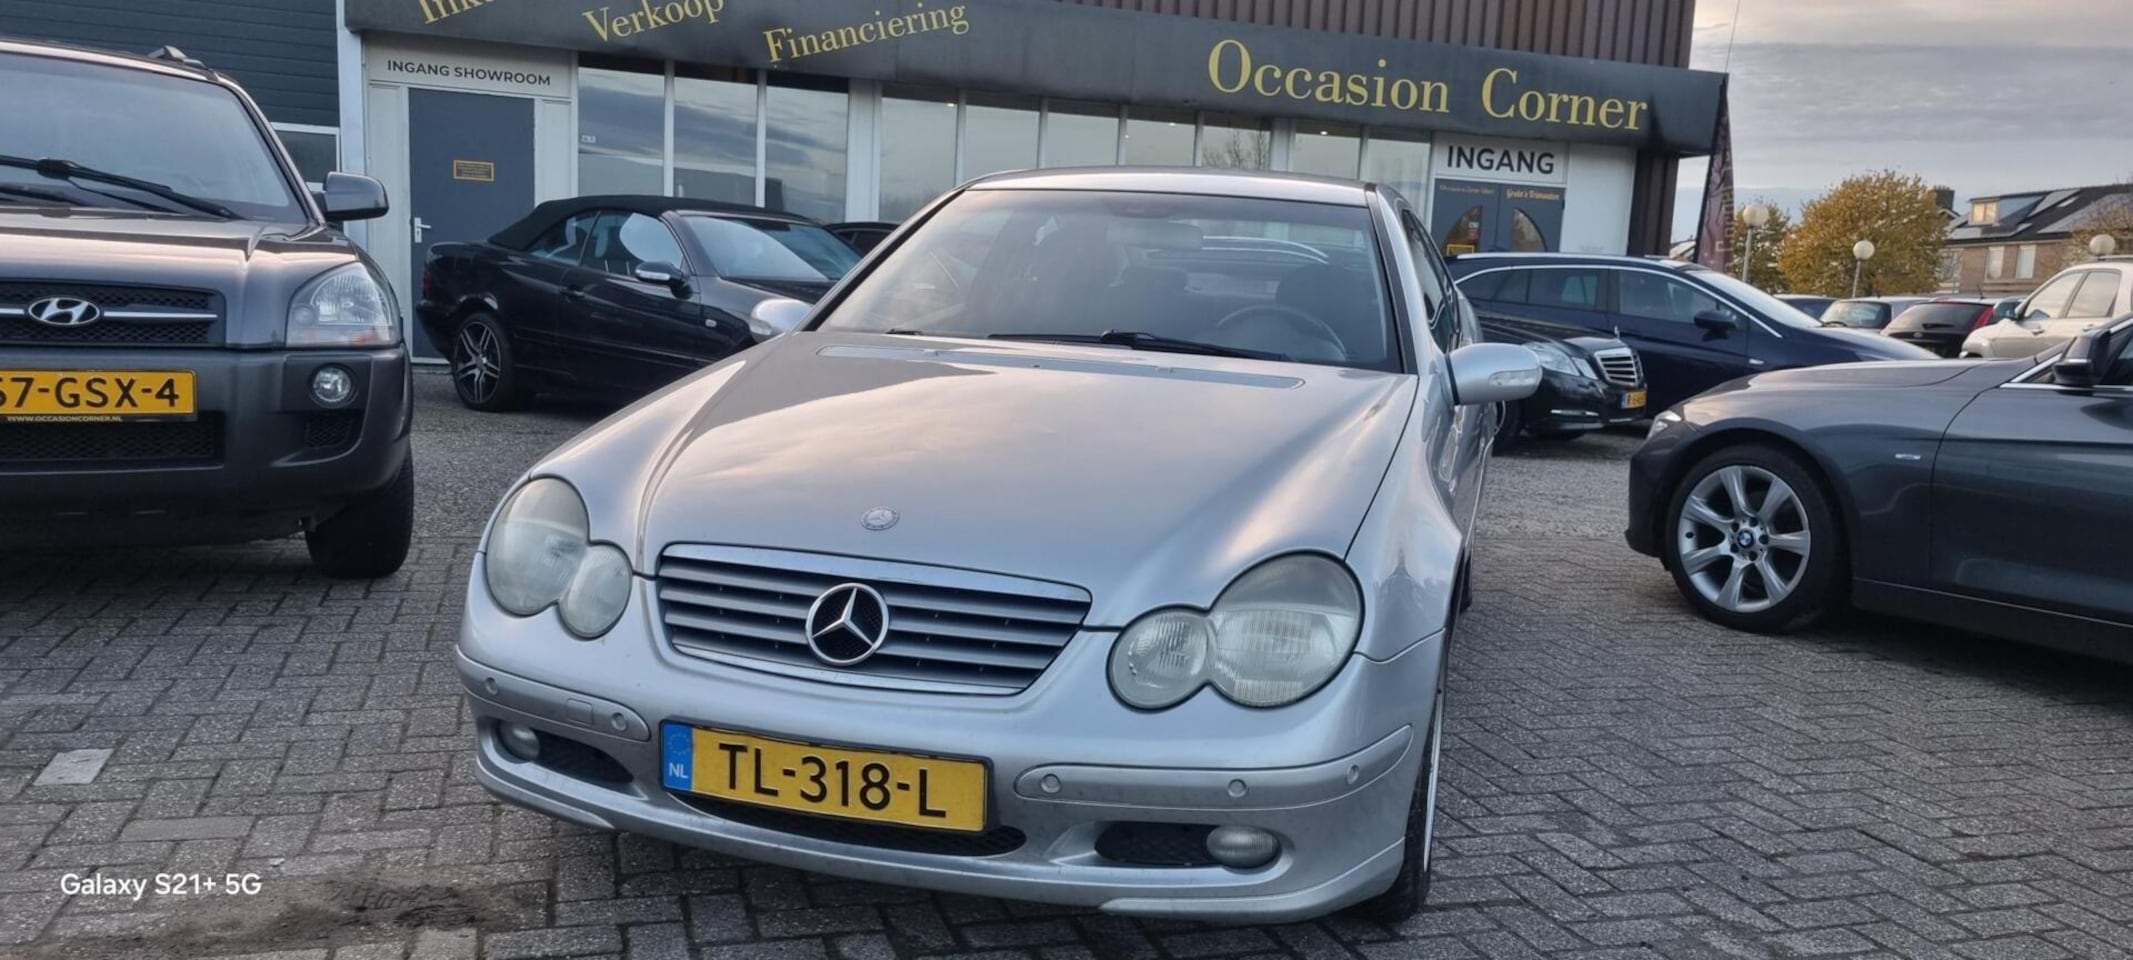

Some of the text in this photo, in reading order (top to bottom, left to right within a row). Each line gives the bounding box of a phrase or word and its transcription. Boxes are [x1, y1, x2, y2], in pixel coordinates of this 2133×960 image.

[582, 0, 723, 42] Verkoop
[762, 2, 969, 62] Financiering
[387, 59, 551, 86] INGANG SHOWROOM
[1207, 39, 1648, 131] Occasion Corner
[1447, 145, 1555, 175] INGANG
[669, 763, 688, 779] NL
[718, 742, 947, 818] TL-318-L
